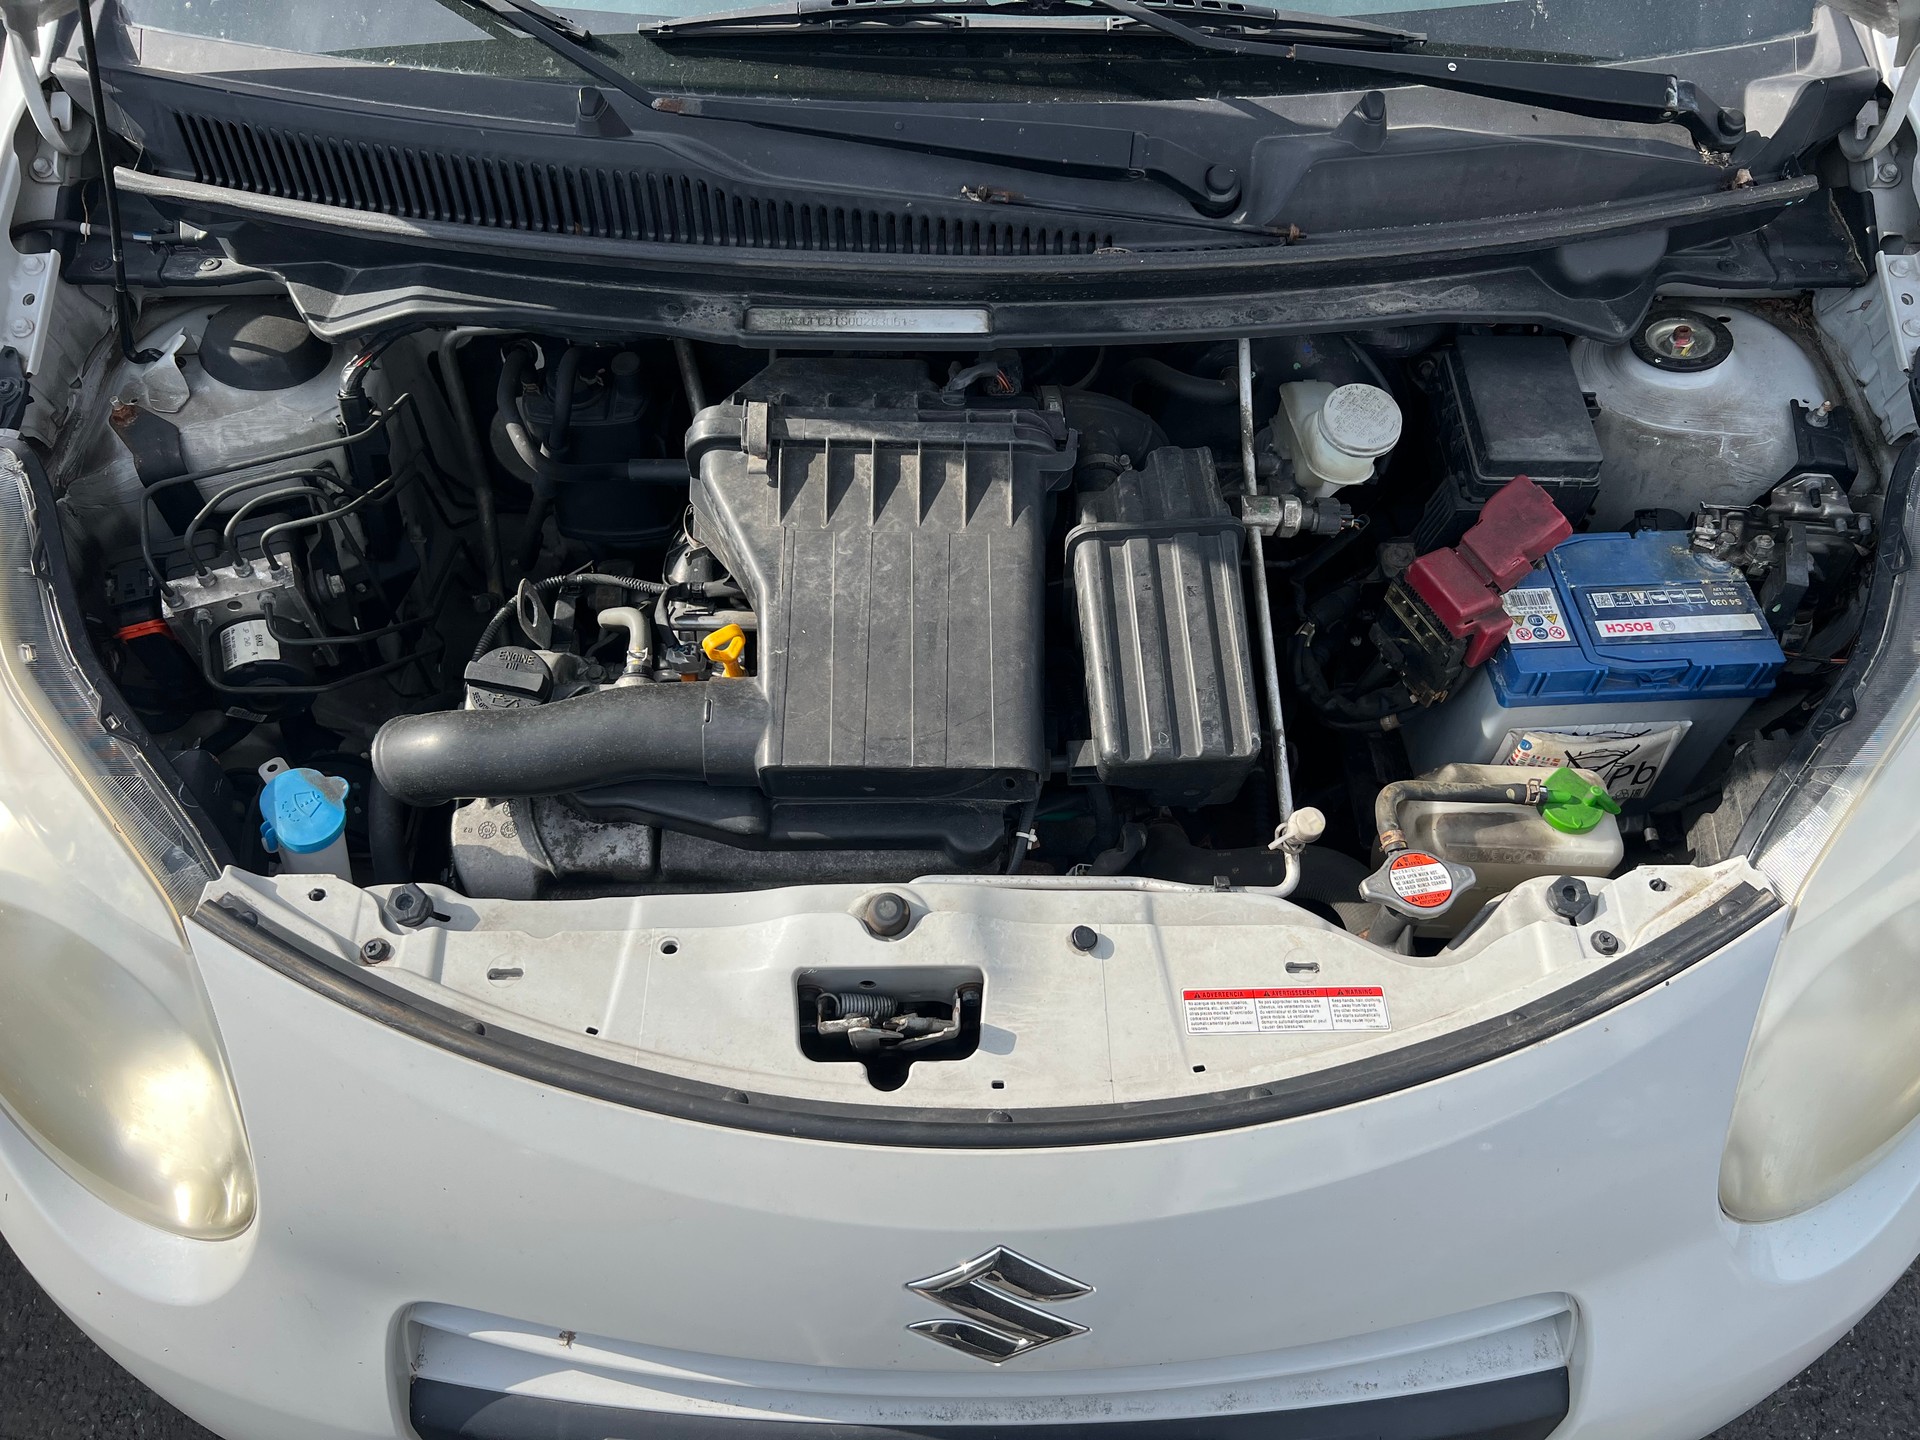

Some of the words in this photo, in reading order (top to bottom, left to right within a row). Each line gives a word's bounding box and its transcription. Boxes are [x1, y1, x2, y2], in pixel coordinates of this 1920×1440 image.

[1605, 622, 1654, 634] BOSCH
[499, 651, 536, 665] ENGINE
[1606, 760, 1656, 790] Pb
